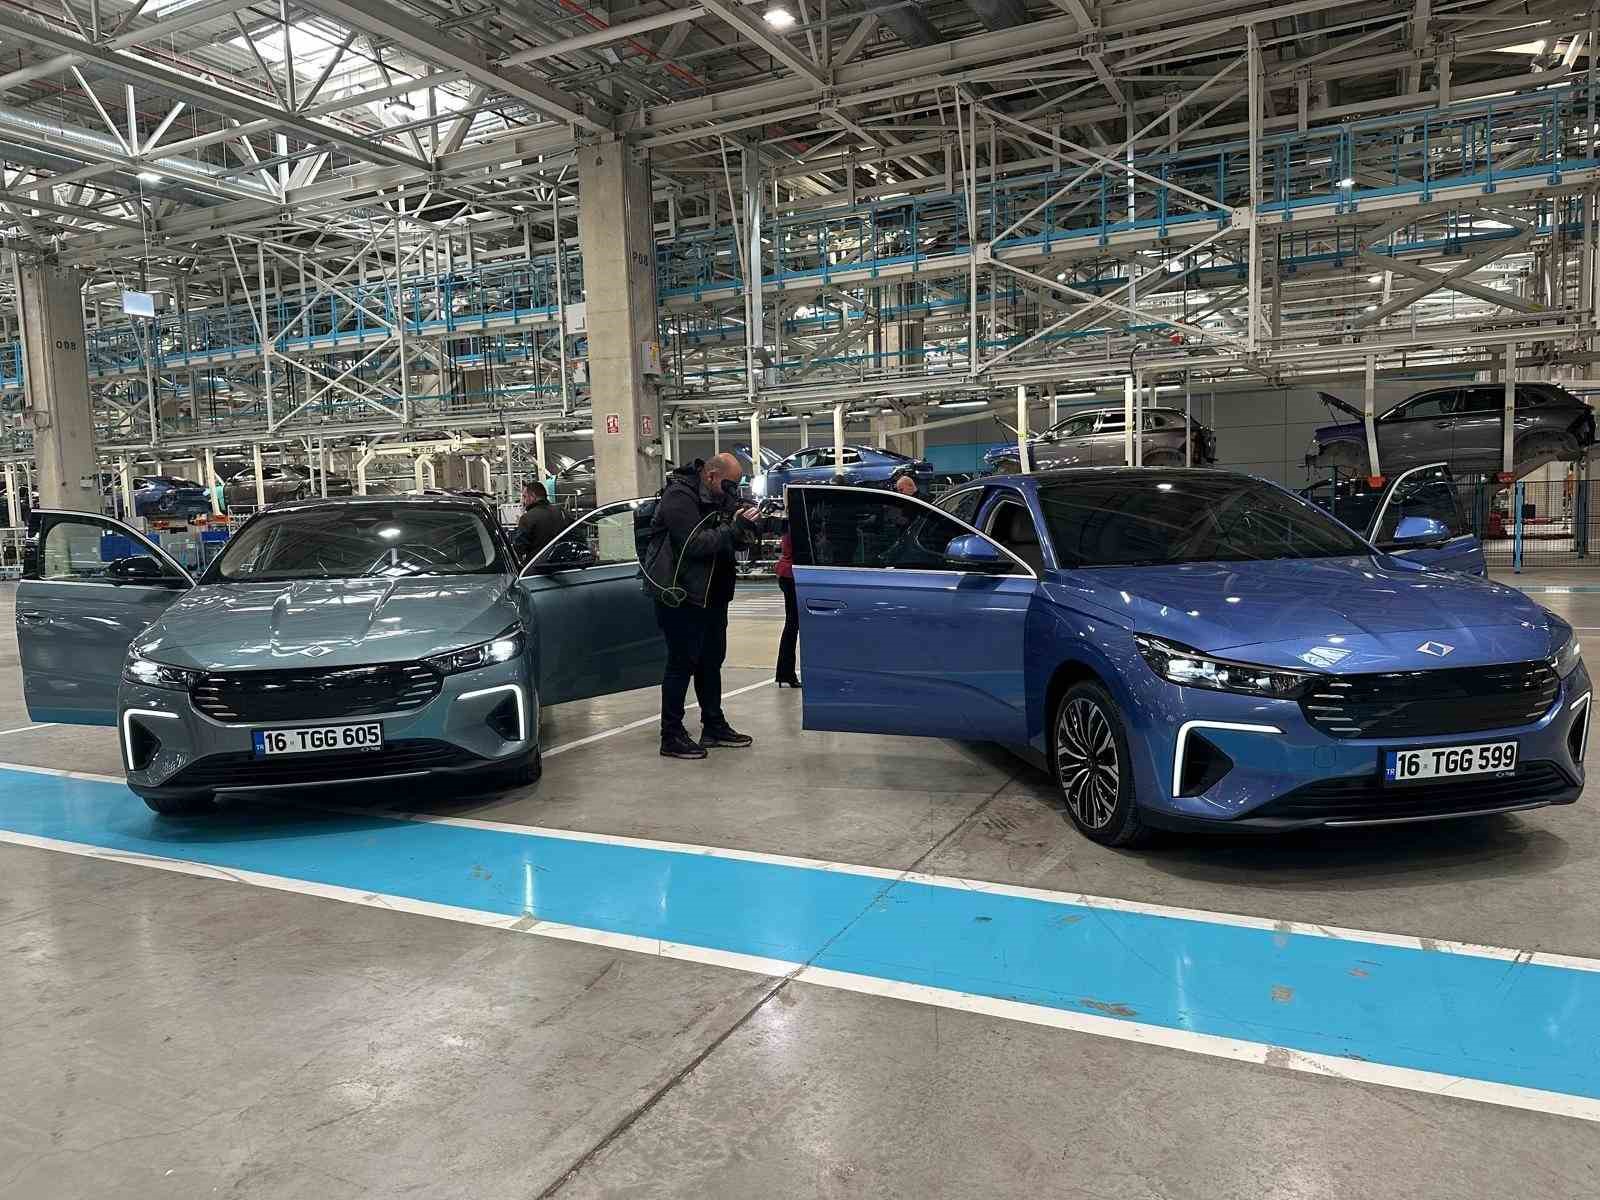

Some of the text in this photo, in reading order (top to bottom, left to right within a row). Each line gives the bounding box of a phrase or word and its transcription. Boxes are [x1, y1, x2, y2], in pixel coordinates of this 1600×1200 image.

[255, 743, 265, 752] TR
[265, 725, 380, 752] 16 TGG 605
[1398, 744, 1515, 777] 16 TGG 599
[1386, 768, 1396, 776] TR
